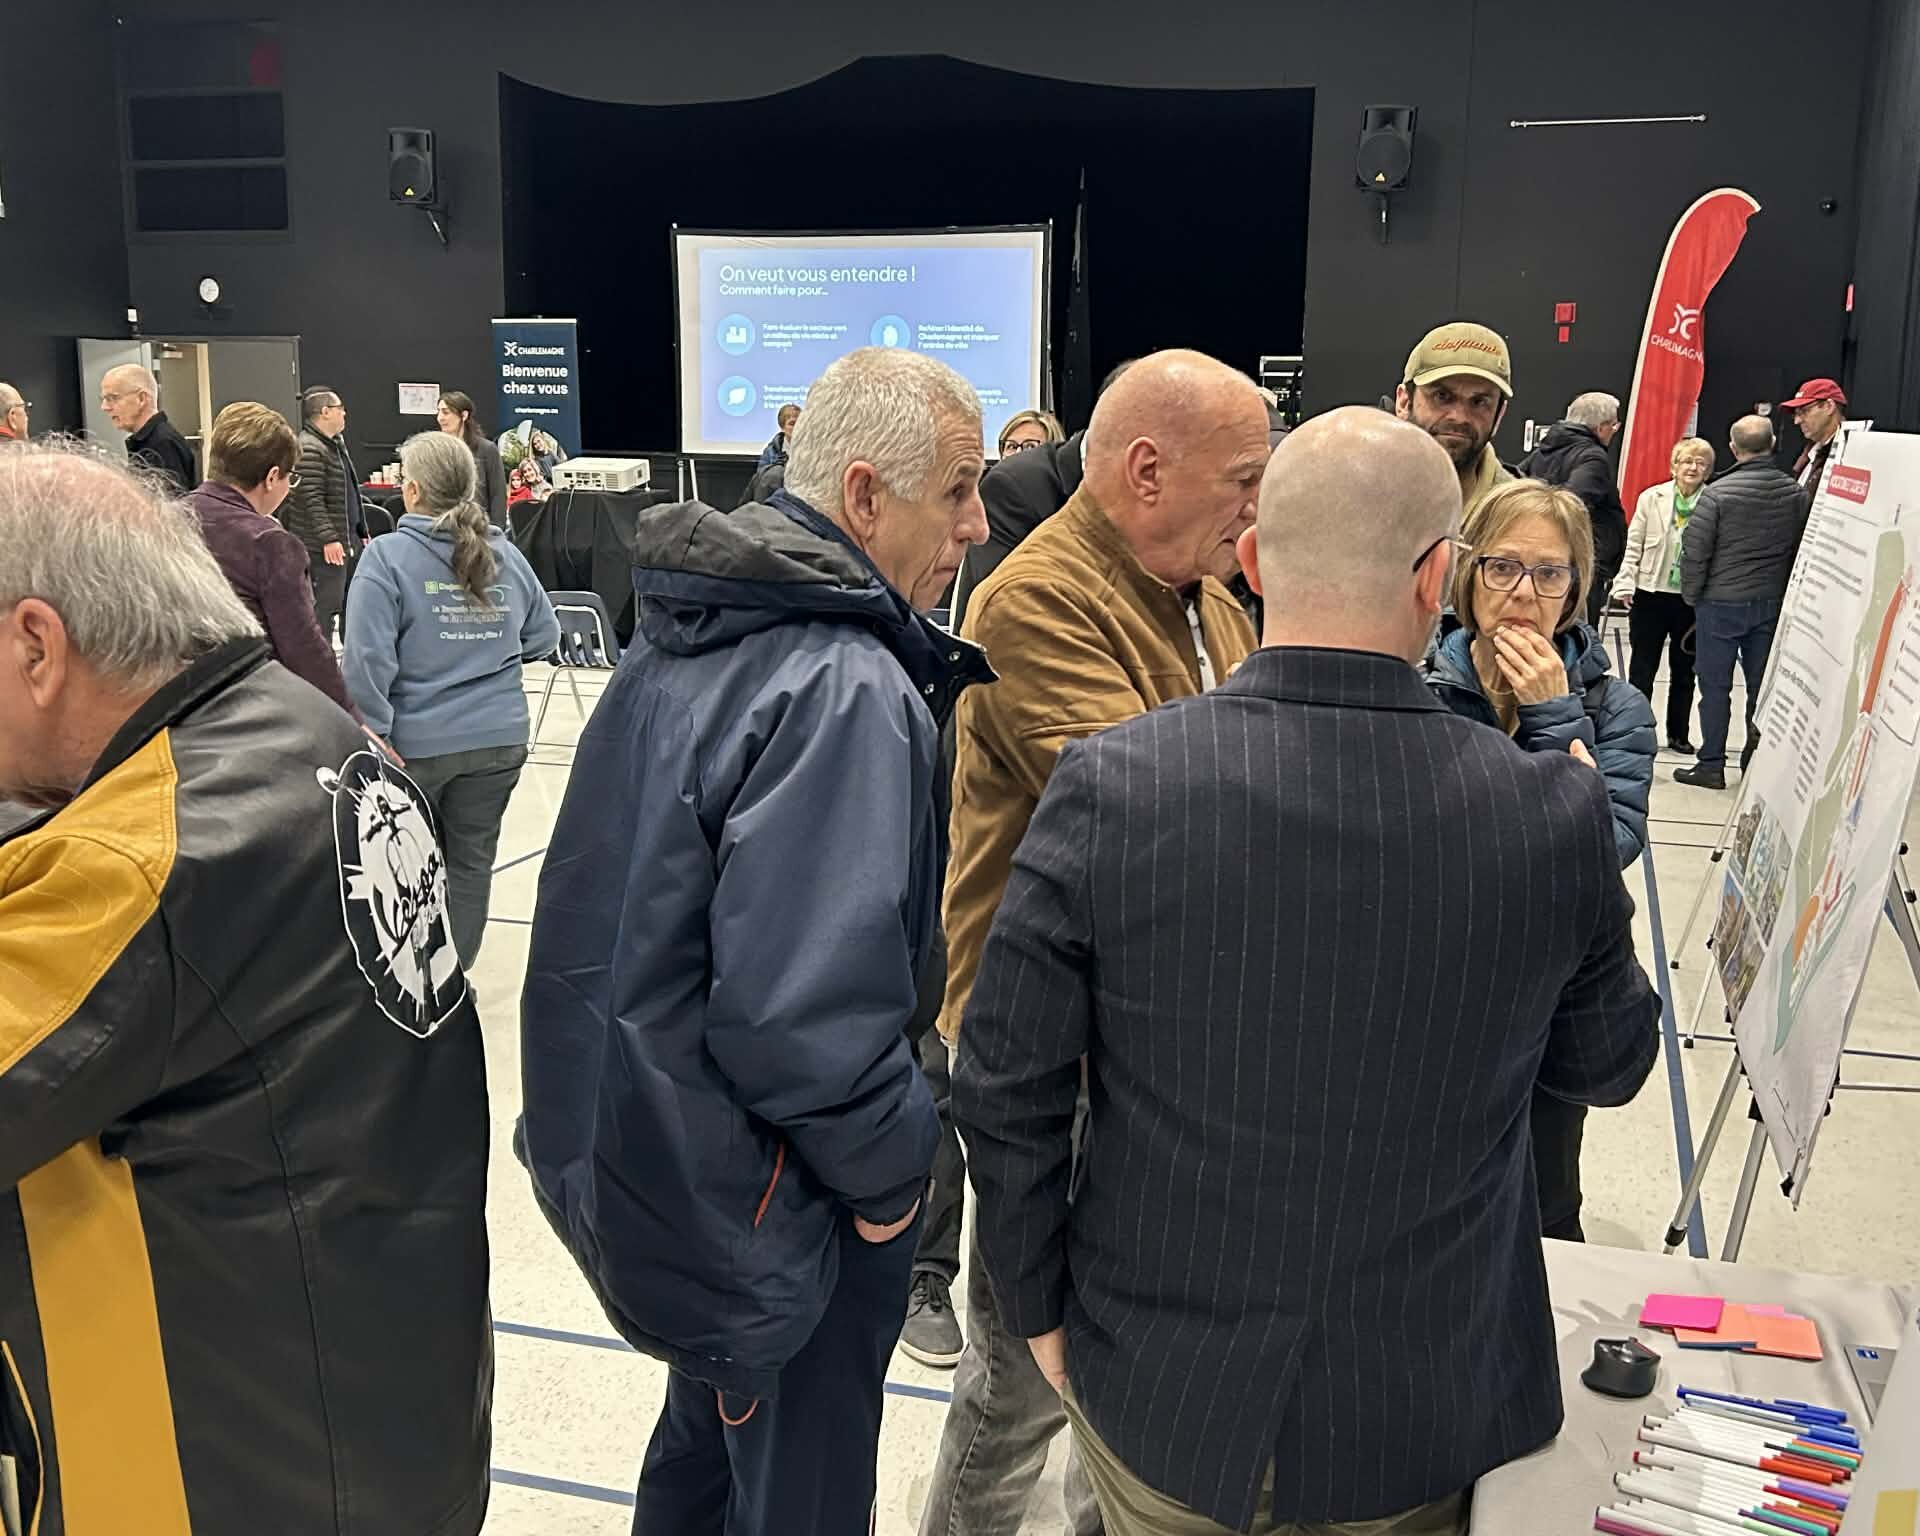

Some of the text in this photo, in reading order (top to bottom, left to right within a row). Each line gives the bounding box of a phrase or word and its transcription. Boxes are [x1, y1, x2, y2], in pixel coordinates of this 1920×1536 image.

[719, 264, 745, 282] On
[746, 267, 785, 282] veut
[786, 269, 827, 282] vous
[830, 265, 908, 282] entendre
[719, 283, 771, 296] Comment
[773, 284, 796, 296] faire
[502, 363, 569, 378] Bienvenue
[503, 381, 569, 395] chez vous
